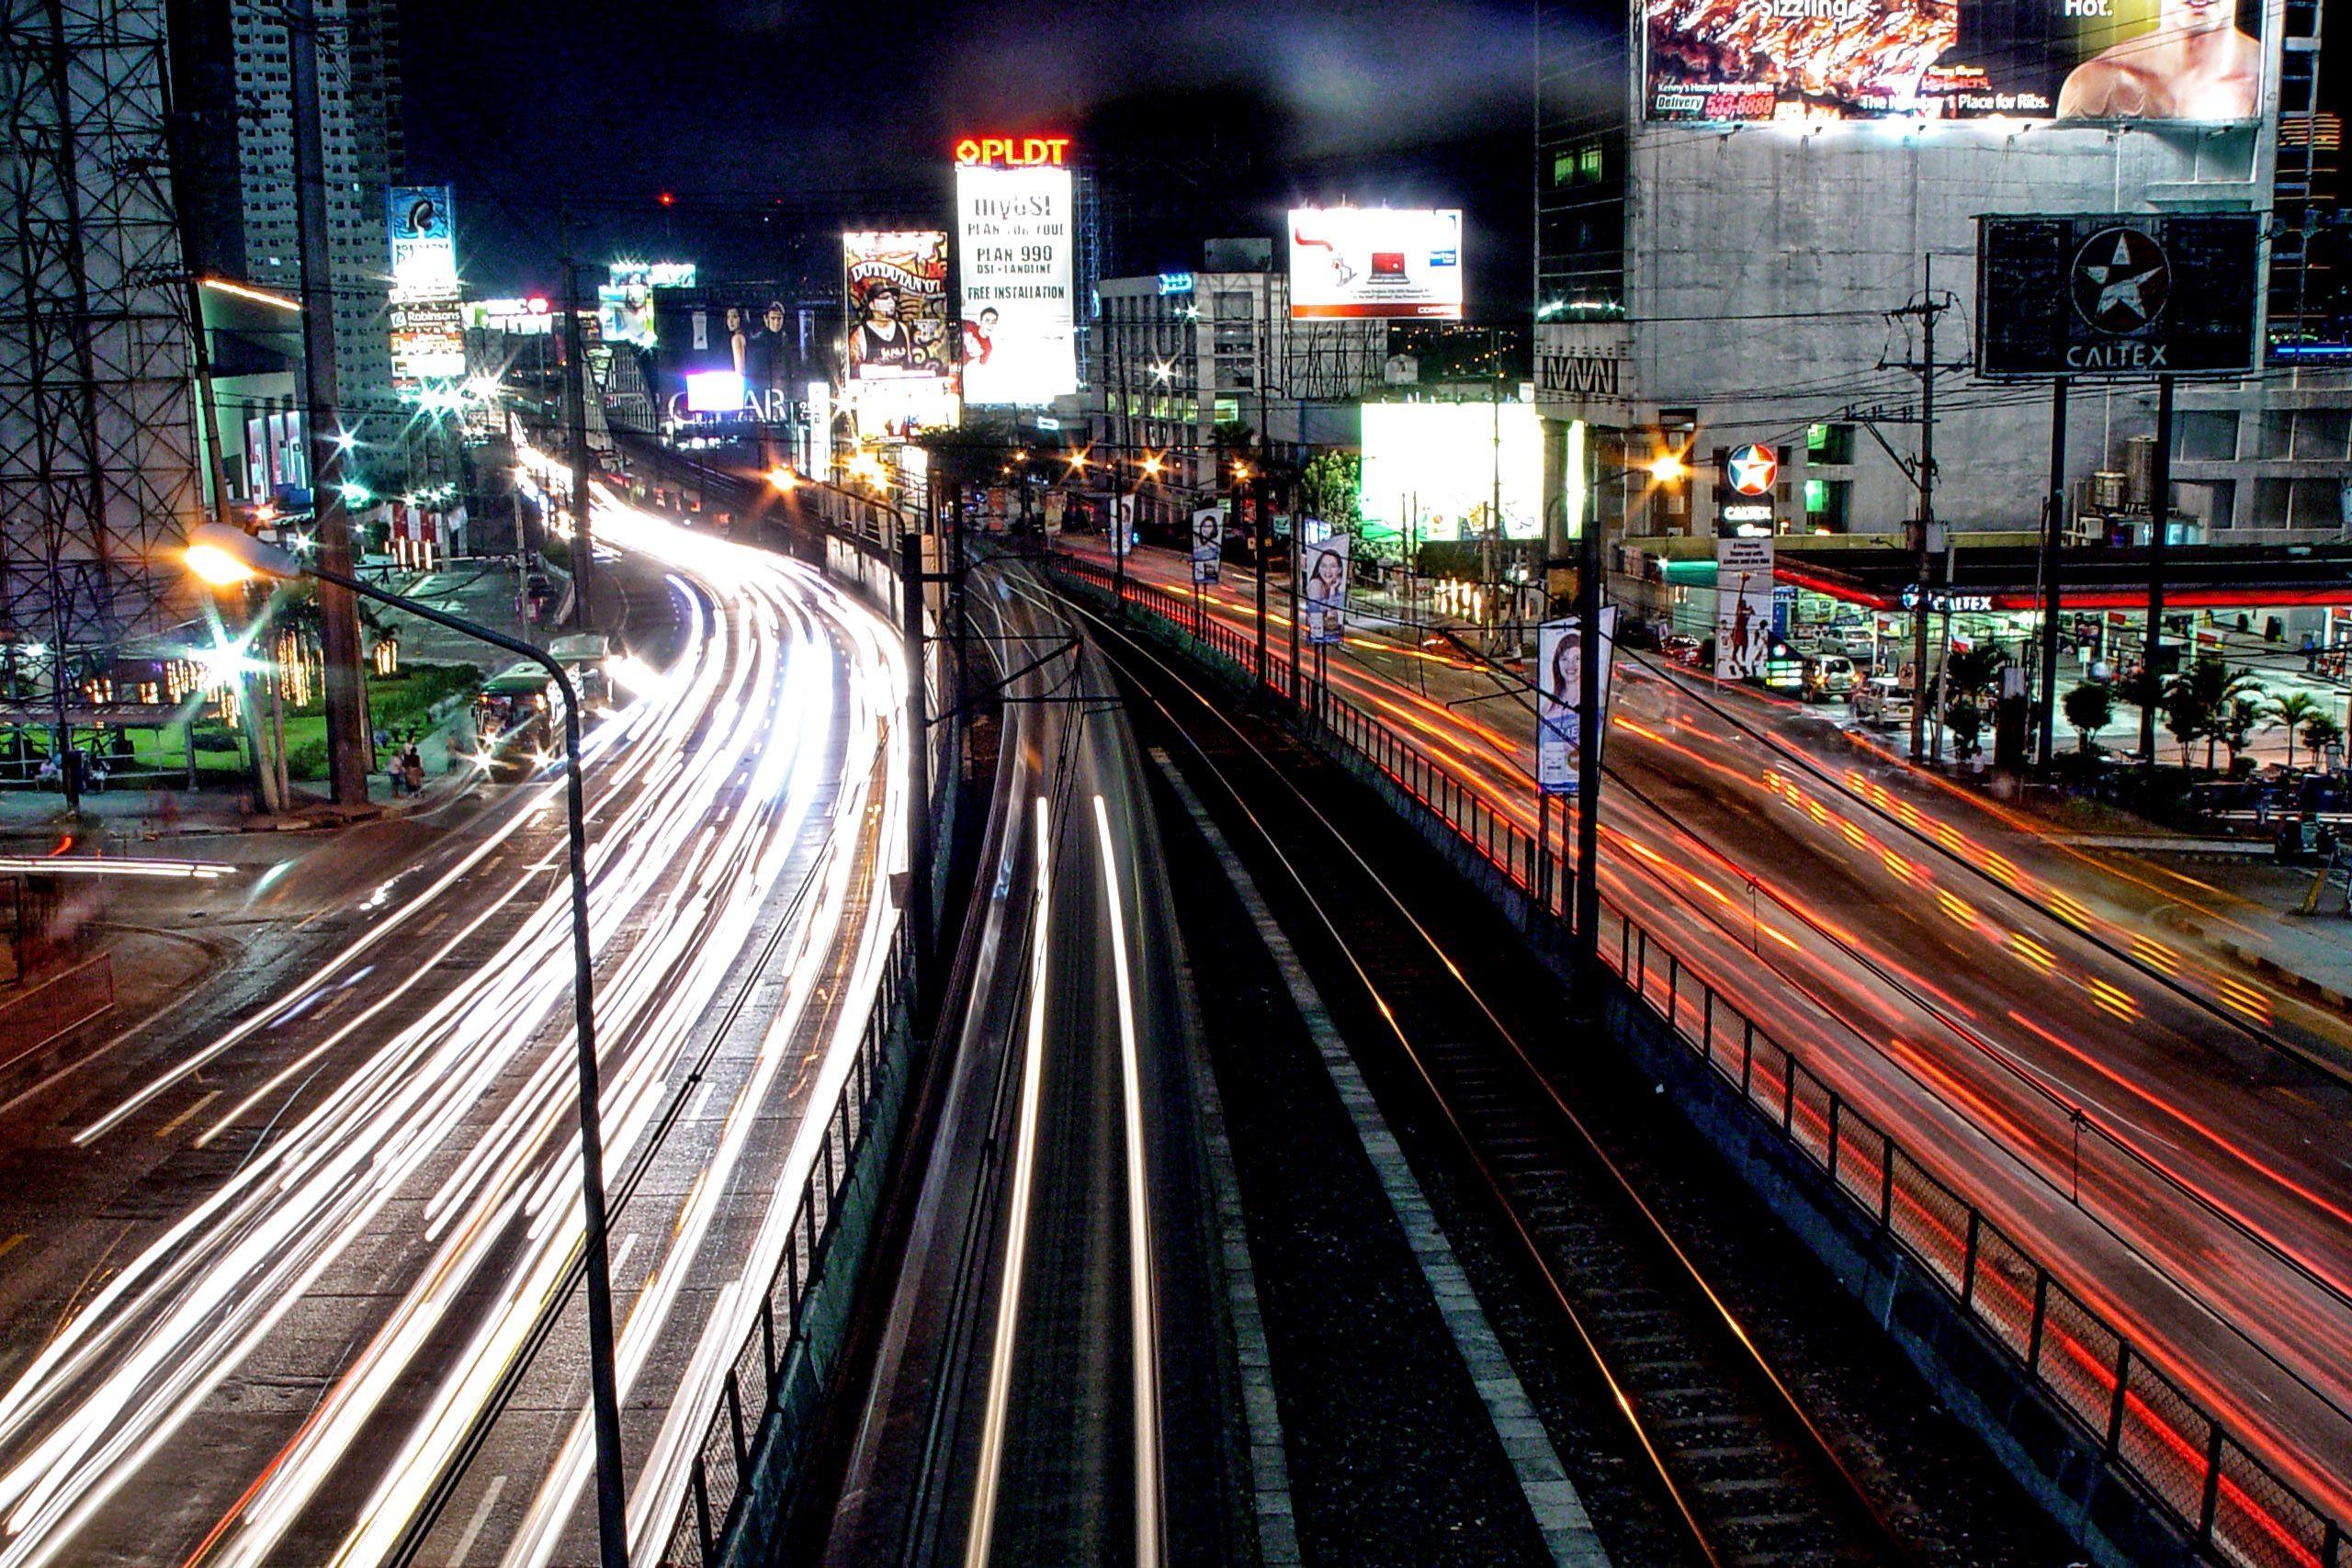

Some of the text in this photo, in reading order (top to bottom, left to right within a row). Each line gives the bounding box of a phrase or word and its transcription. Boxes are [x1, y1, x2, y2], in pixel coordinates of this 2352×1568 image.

[2064, 0, 2114, 17] Hot.
[1658, 96, 1702, 108] Delivery
[1861, 95, 1886, 109] The
[1888, 95, 1946, 109] Nmbr
[1958, 94, 1994, 109] Place
[1996, 94, 2016, 108] for
[2018, 94, 2050, 109] Ribs.
[982, 139, 1069, 165] PLDT
[977, 245, 1053, 262] PLAN 990
[977, 264, 994, 274] DSL
[1004, 264, 1051, 274] LANDLINE
[967, 286, 1065, 299] FREE INSTALLATION
[407, 310, 460, 322] Robinsons
[2066, 344, 2167, 367] CALTEX
[668, 389, 788, 423] CAR
[1932, 595, 1992, 611] CALTEX
